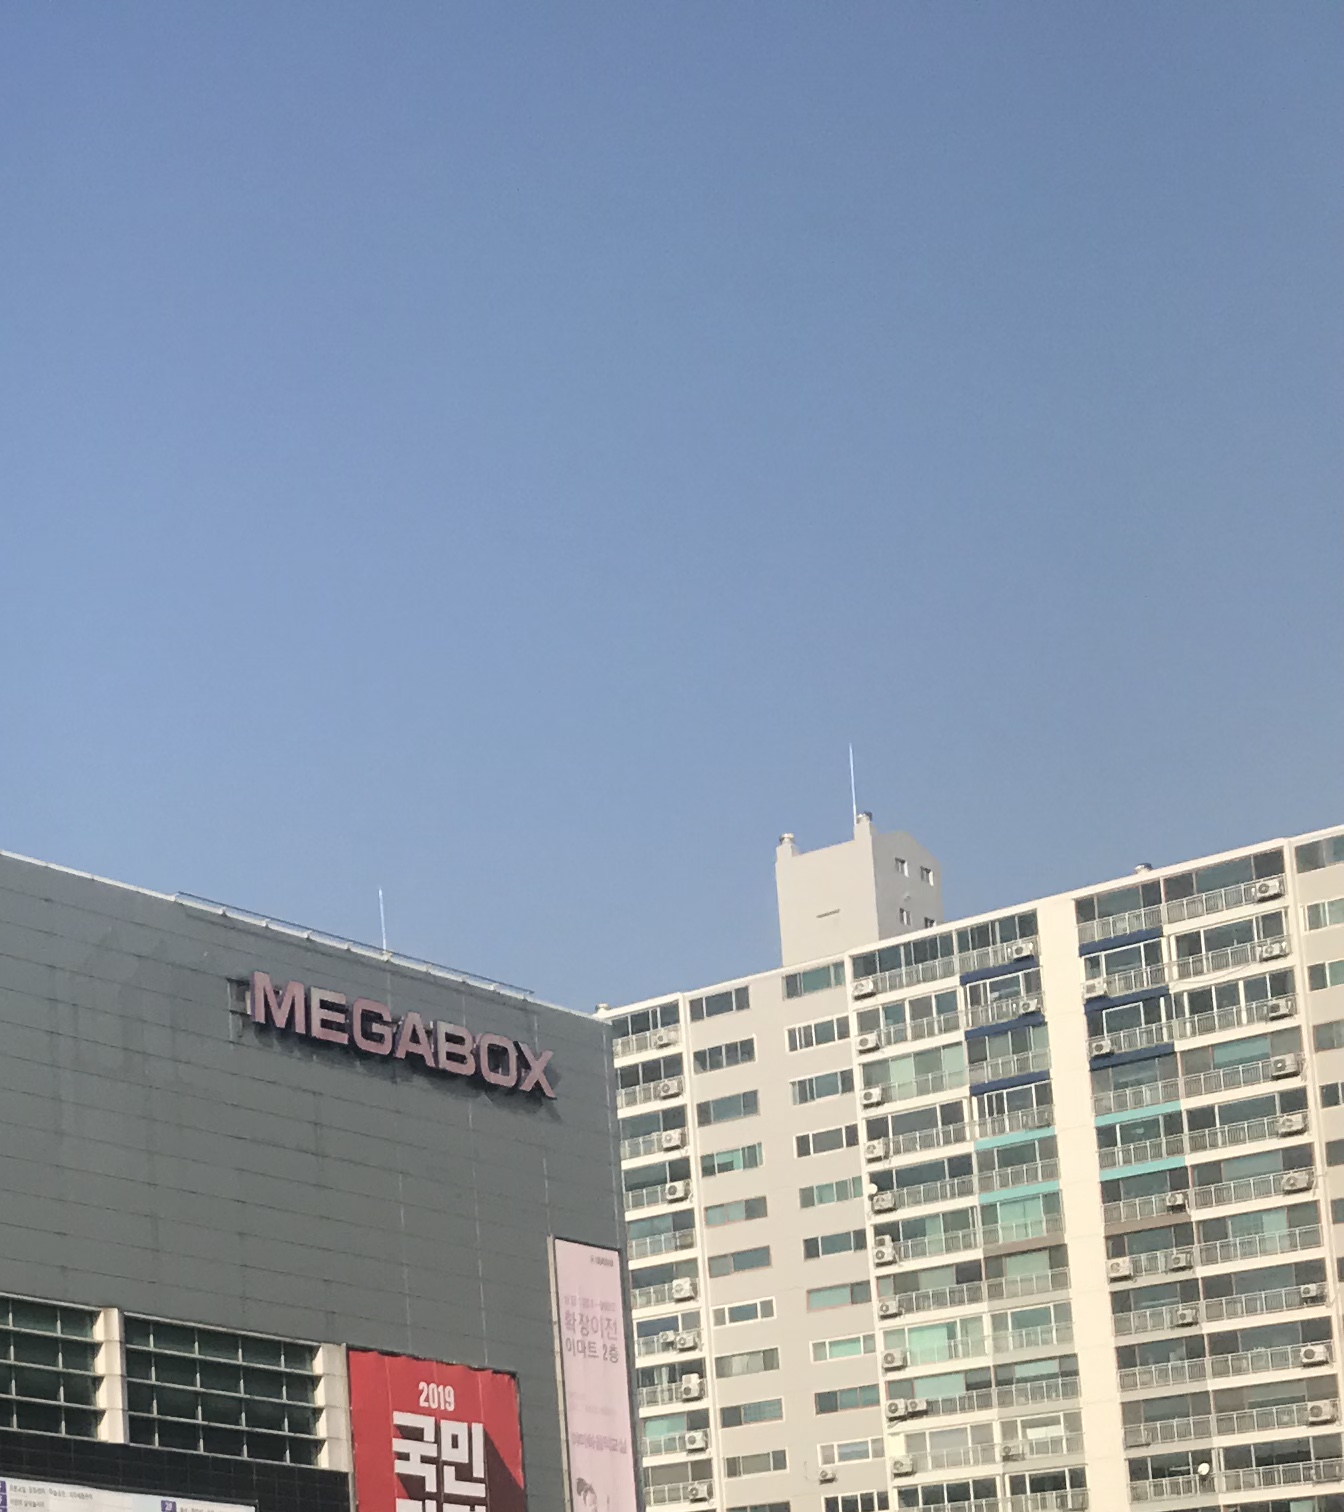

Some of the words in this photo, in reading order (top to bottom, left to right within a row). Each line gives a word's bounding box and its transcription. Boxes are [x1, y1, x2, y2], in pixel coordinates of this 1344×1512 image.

[251, 971, 558, 1100] MEGABOX
[418, 1381, 455, 1411] 2019
[393, 1411, 486, 1497] 국민
